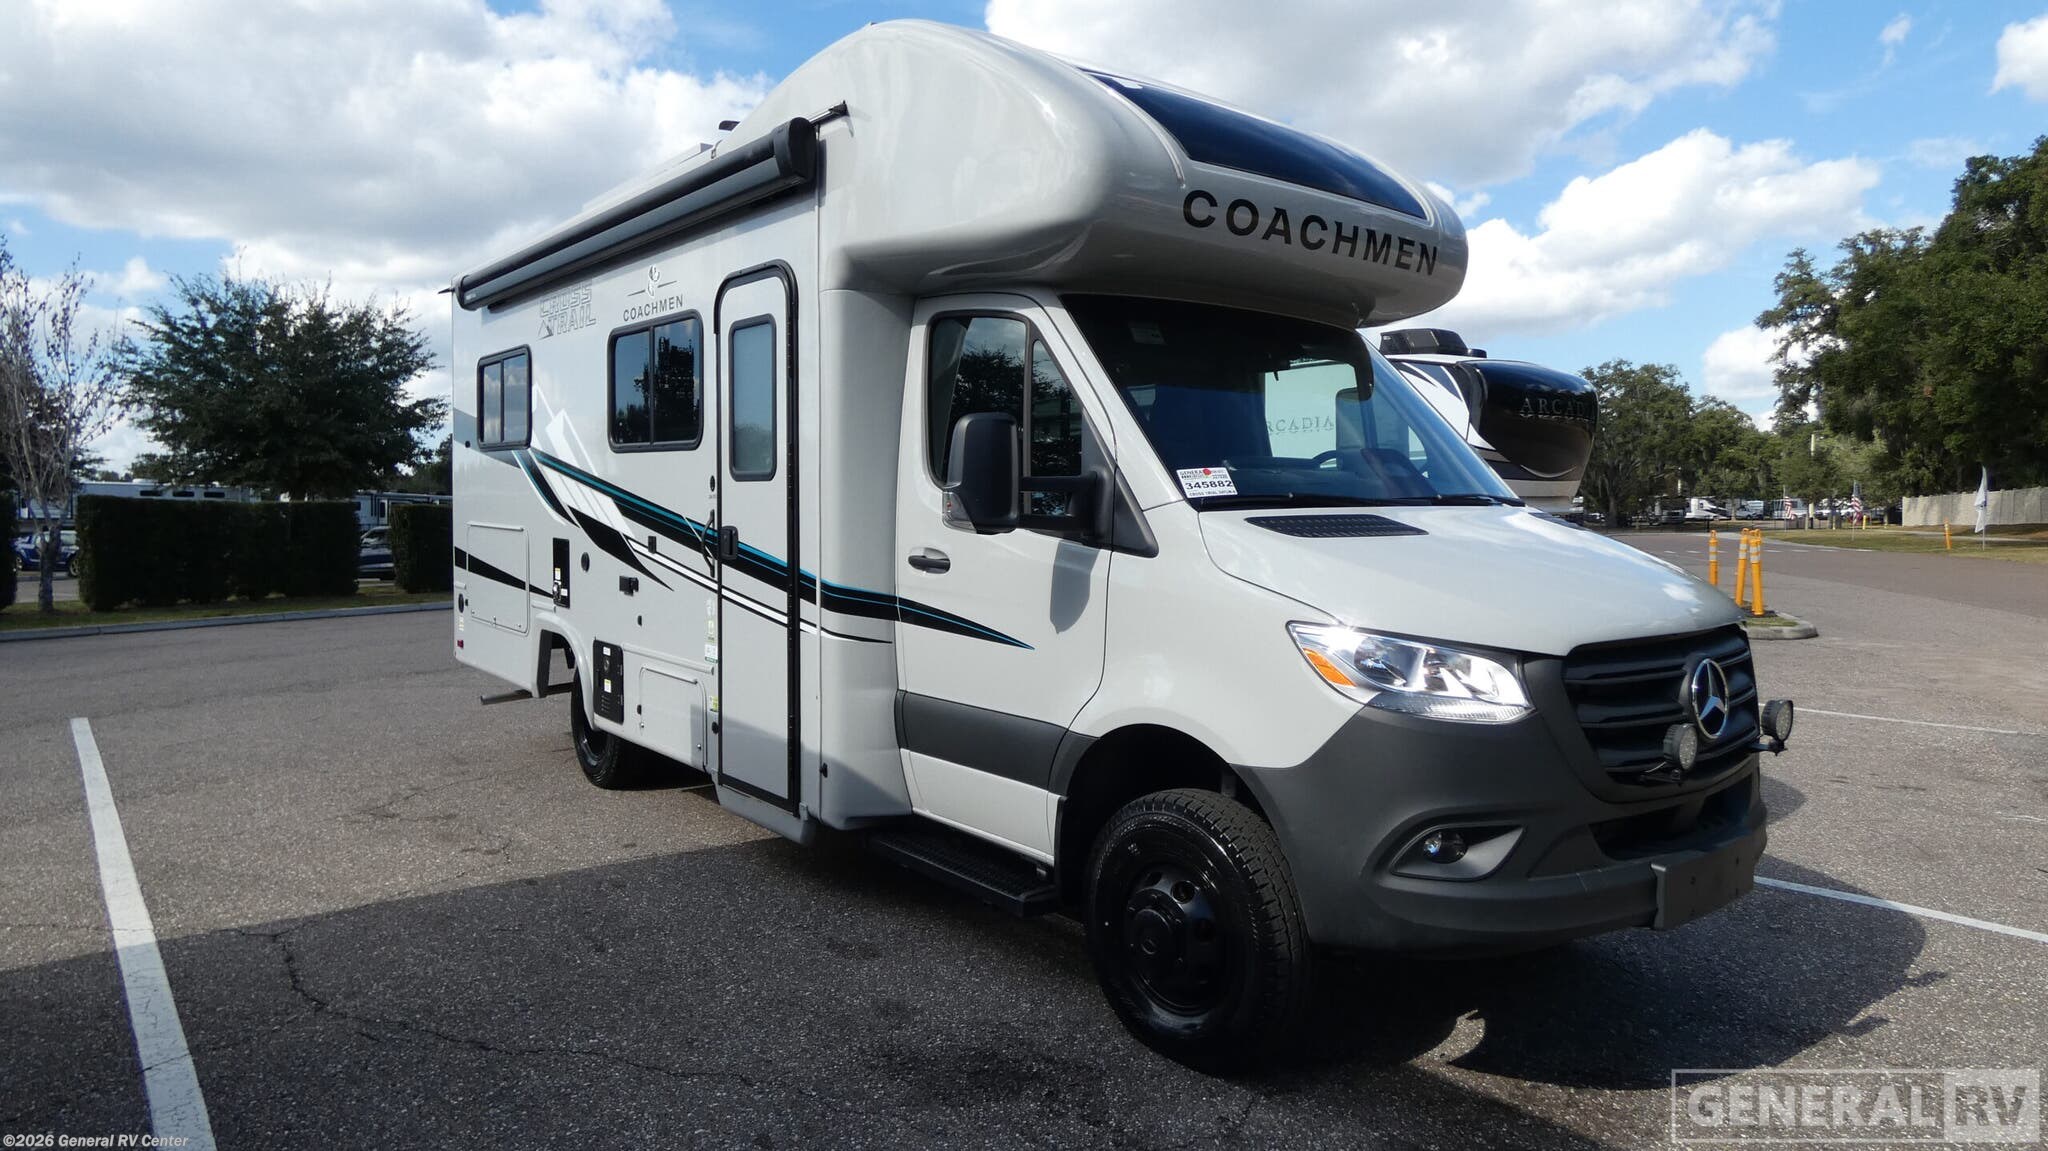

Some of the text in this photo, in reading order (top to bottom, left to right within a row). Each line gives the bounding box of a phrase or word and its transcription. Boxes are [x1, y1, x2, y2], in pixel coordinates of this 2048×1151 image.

[1183, 189, 1438, 276] COACHMEN
[548, 304, 597, 336] TRAIL
[623, 294, 683, 322] COACHMEN
[1519, 397, 1595, 418] ARCAD
[1185, 480, 1233, 490] 345882
